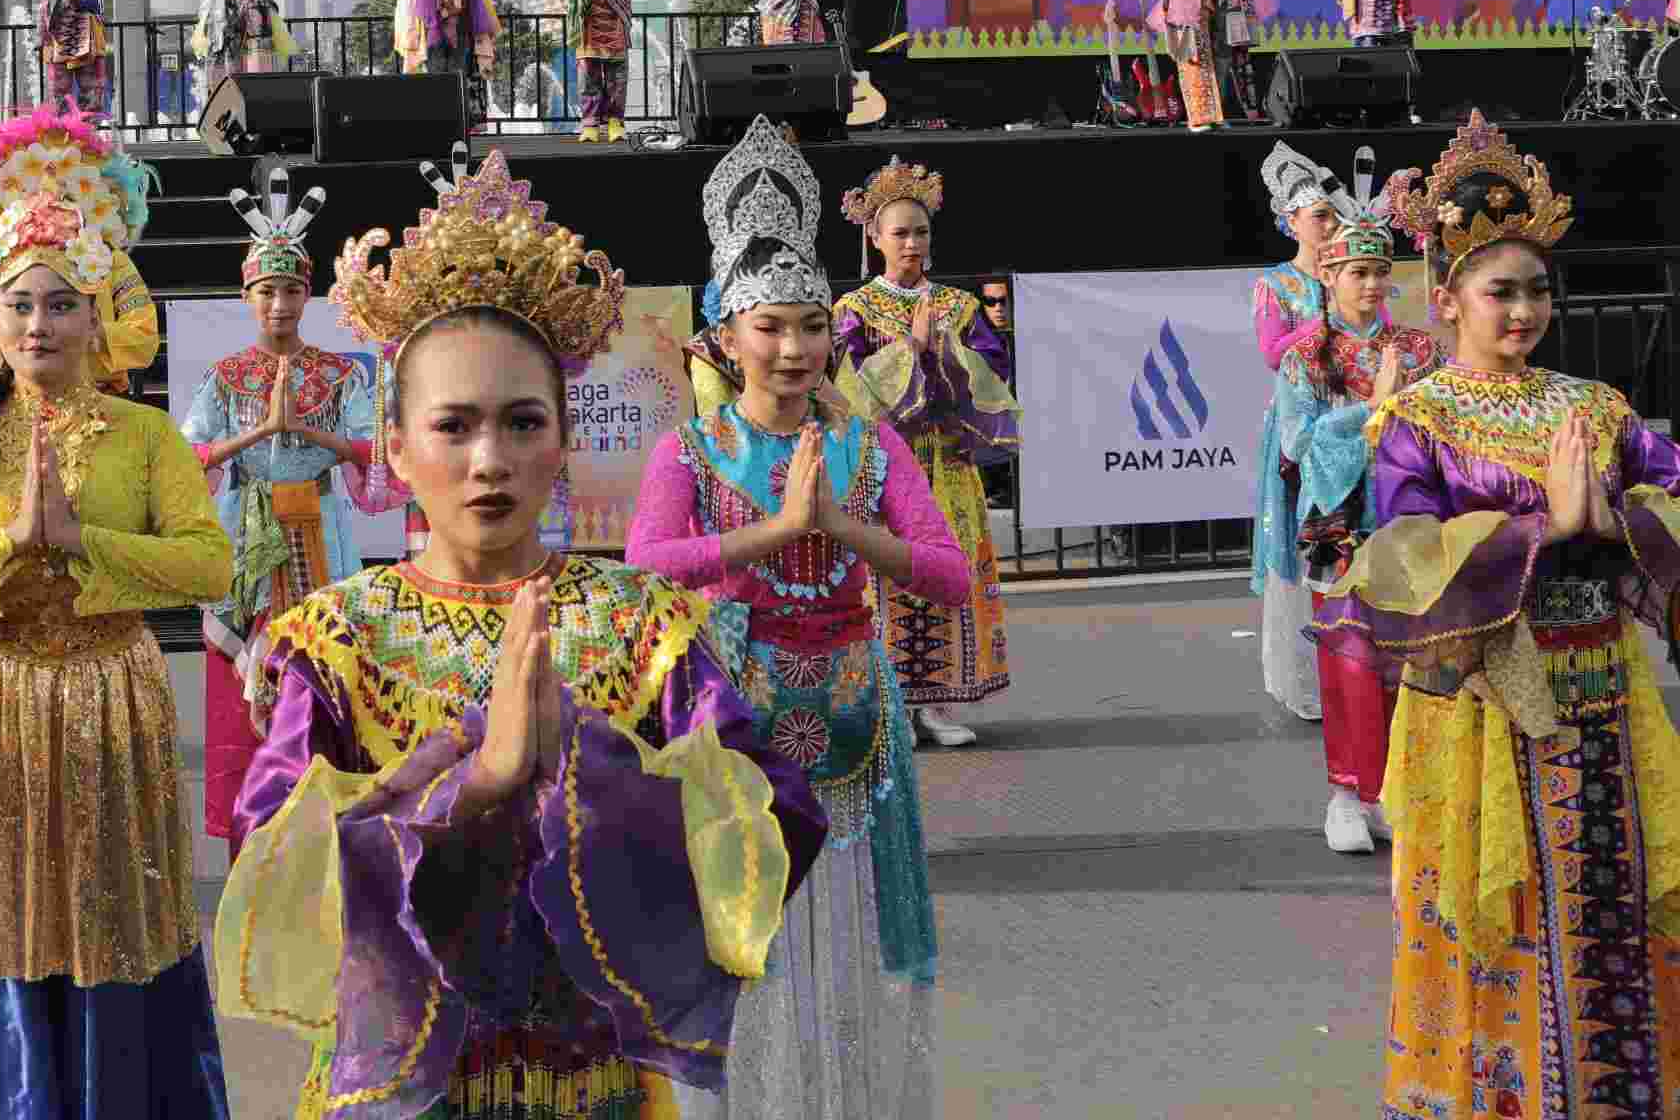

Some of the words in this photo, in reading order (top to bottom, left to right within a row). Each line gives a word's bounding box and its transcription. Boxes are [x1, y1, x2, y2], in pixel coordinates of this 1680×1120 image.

[570, 425, 641, 436] ENUH
[1105, 449, 1163, 472] PAM
[1171, 446, 1236, 469] JAYA
